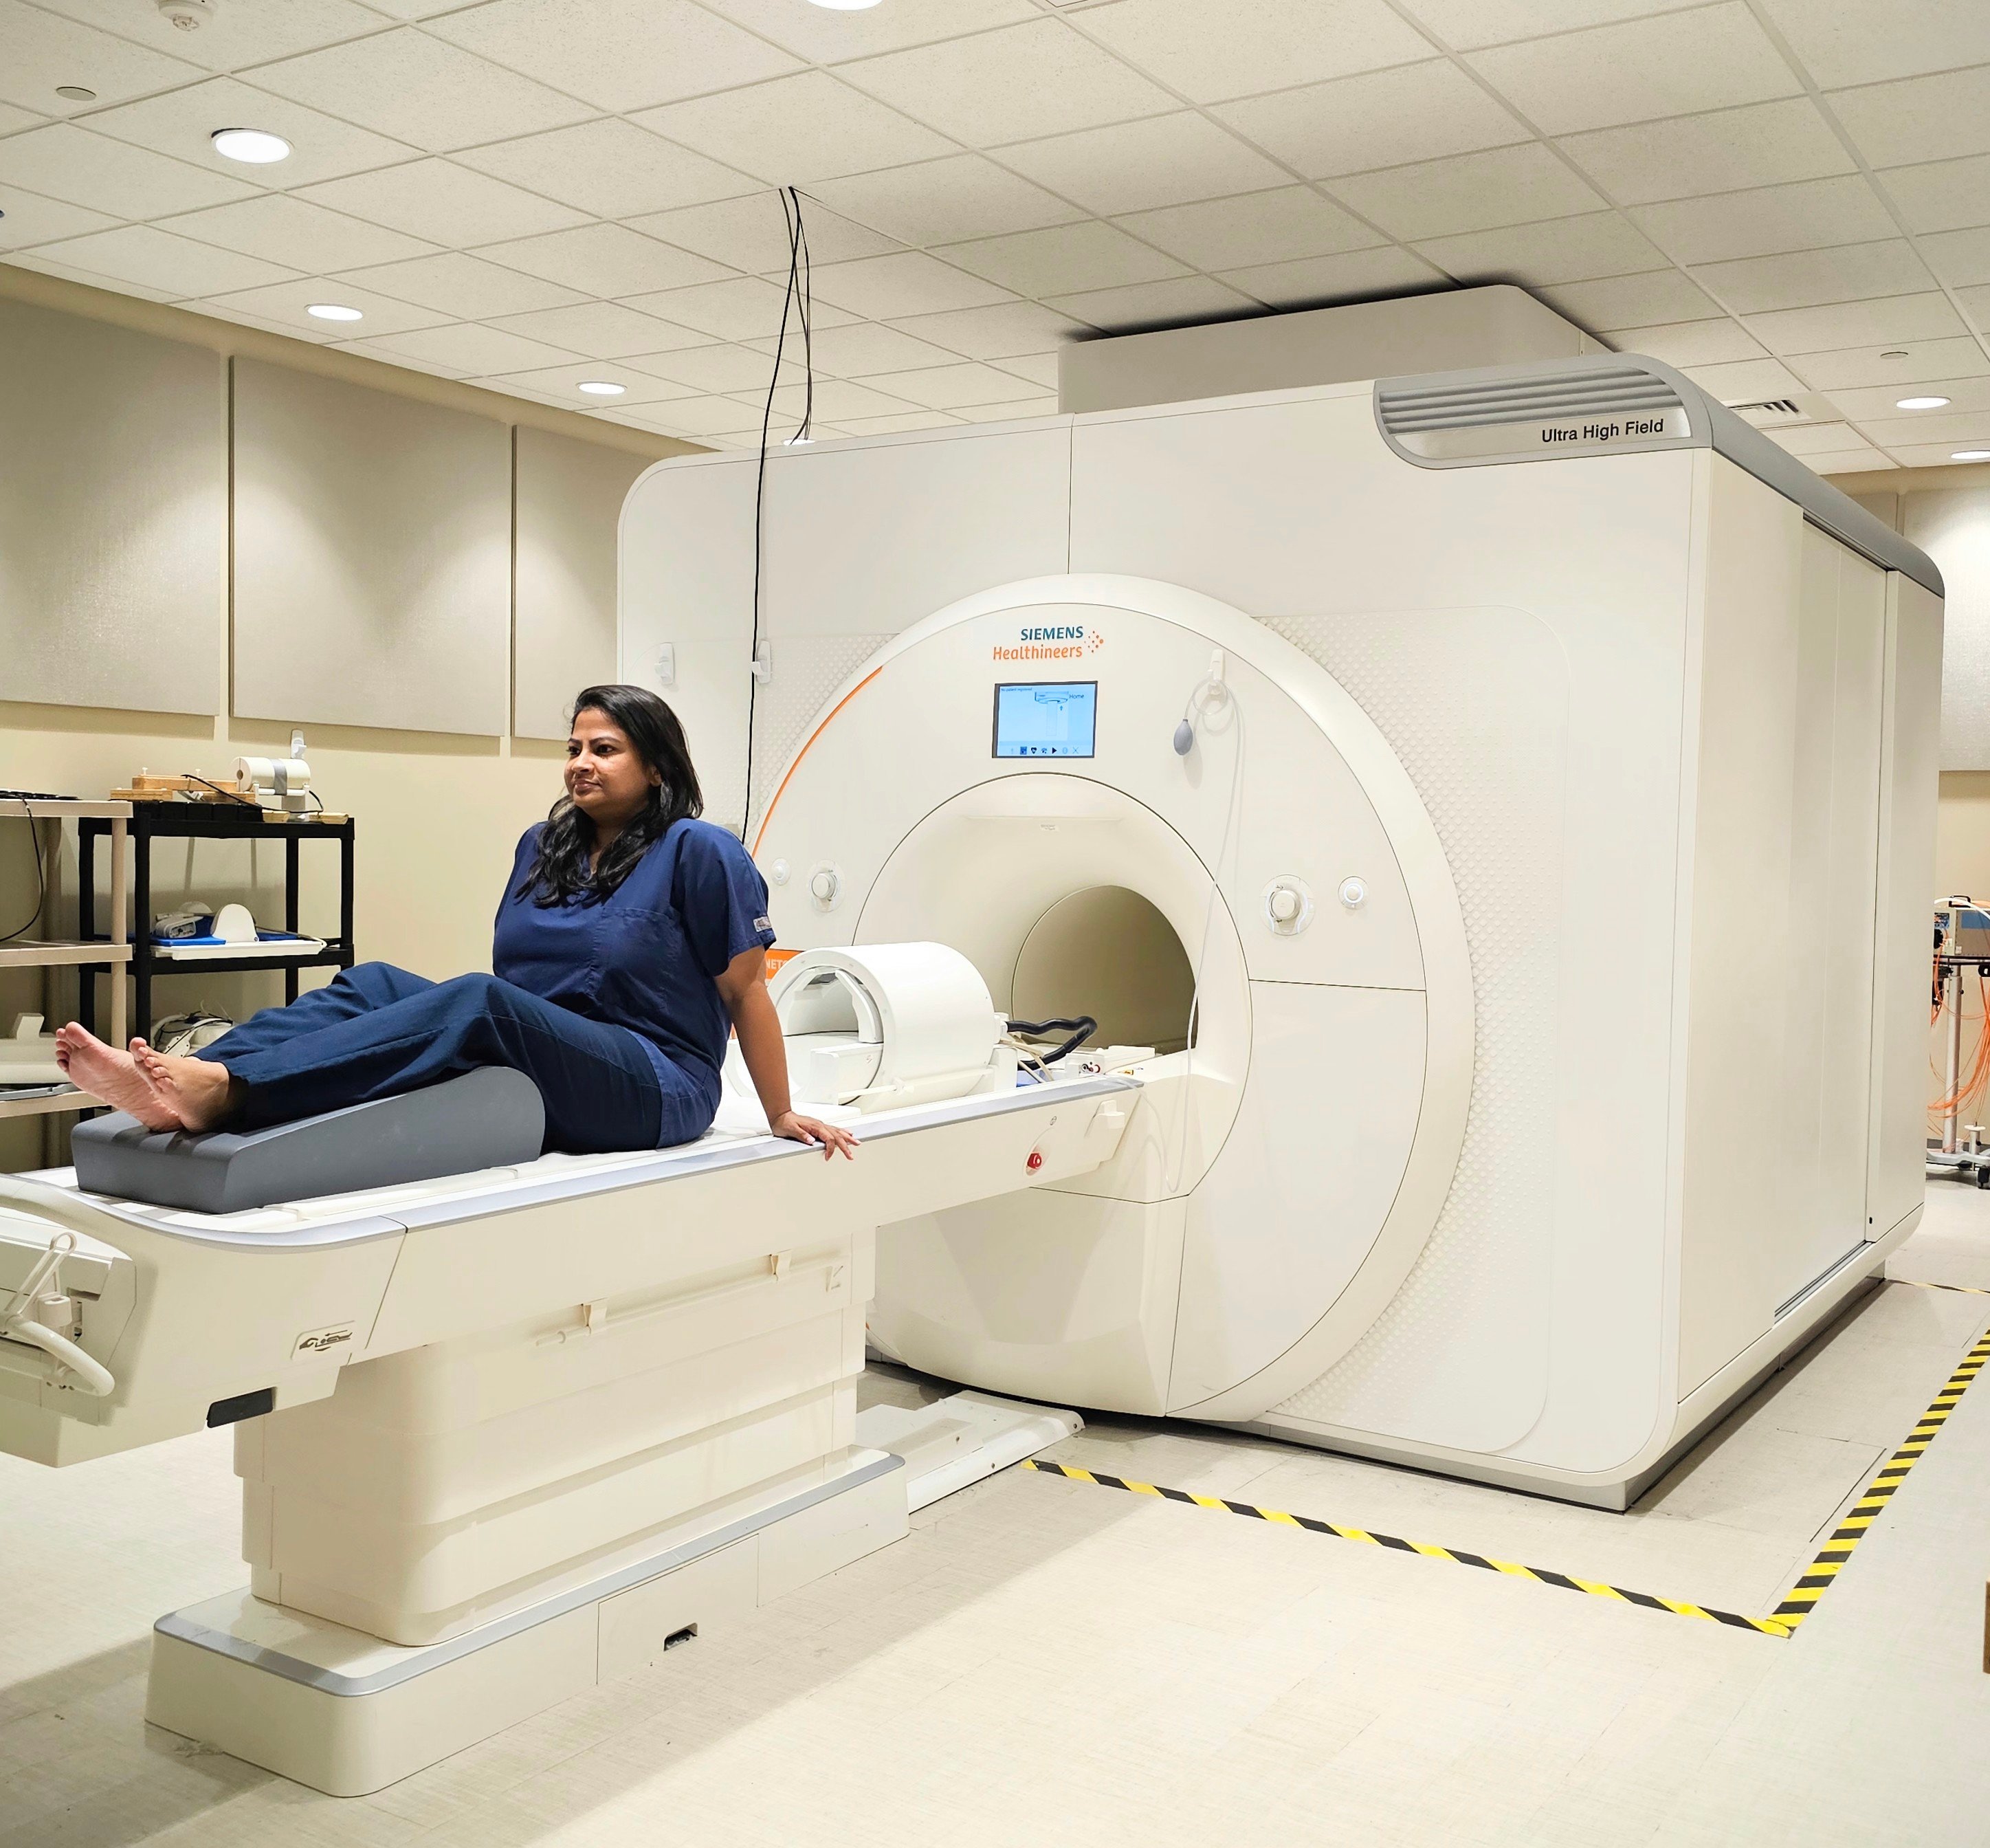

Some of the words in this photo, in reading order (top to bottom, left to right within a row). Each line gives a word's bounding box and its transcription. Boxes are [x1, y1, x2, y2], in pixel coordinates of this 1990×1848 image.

[1542, 428, 1578, 442] Ultra
[1583, 424, 1619, 441] High
[1625, 419, 1663, 435] Field
[1021, 626, 1083, 640] SIEMENS
[993, 645, 1082, 659] Healthineers
